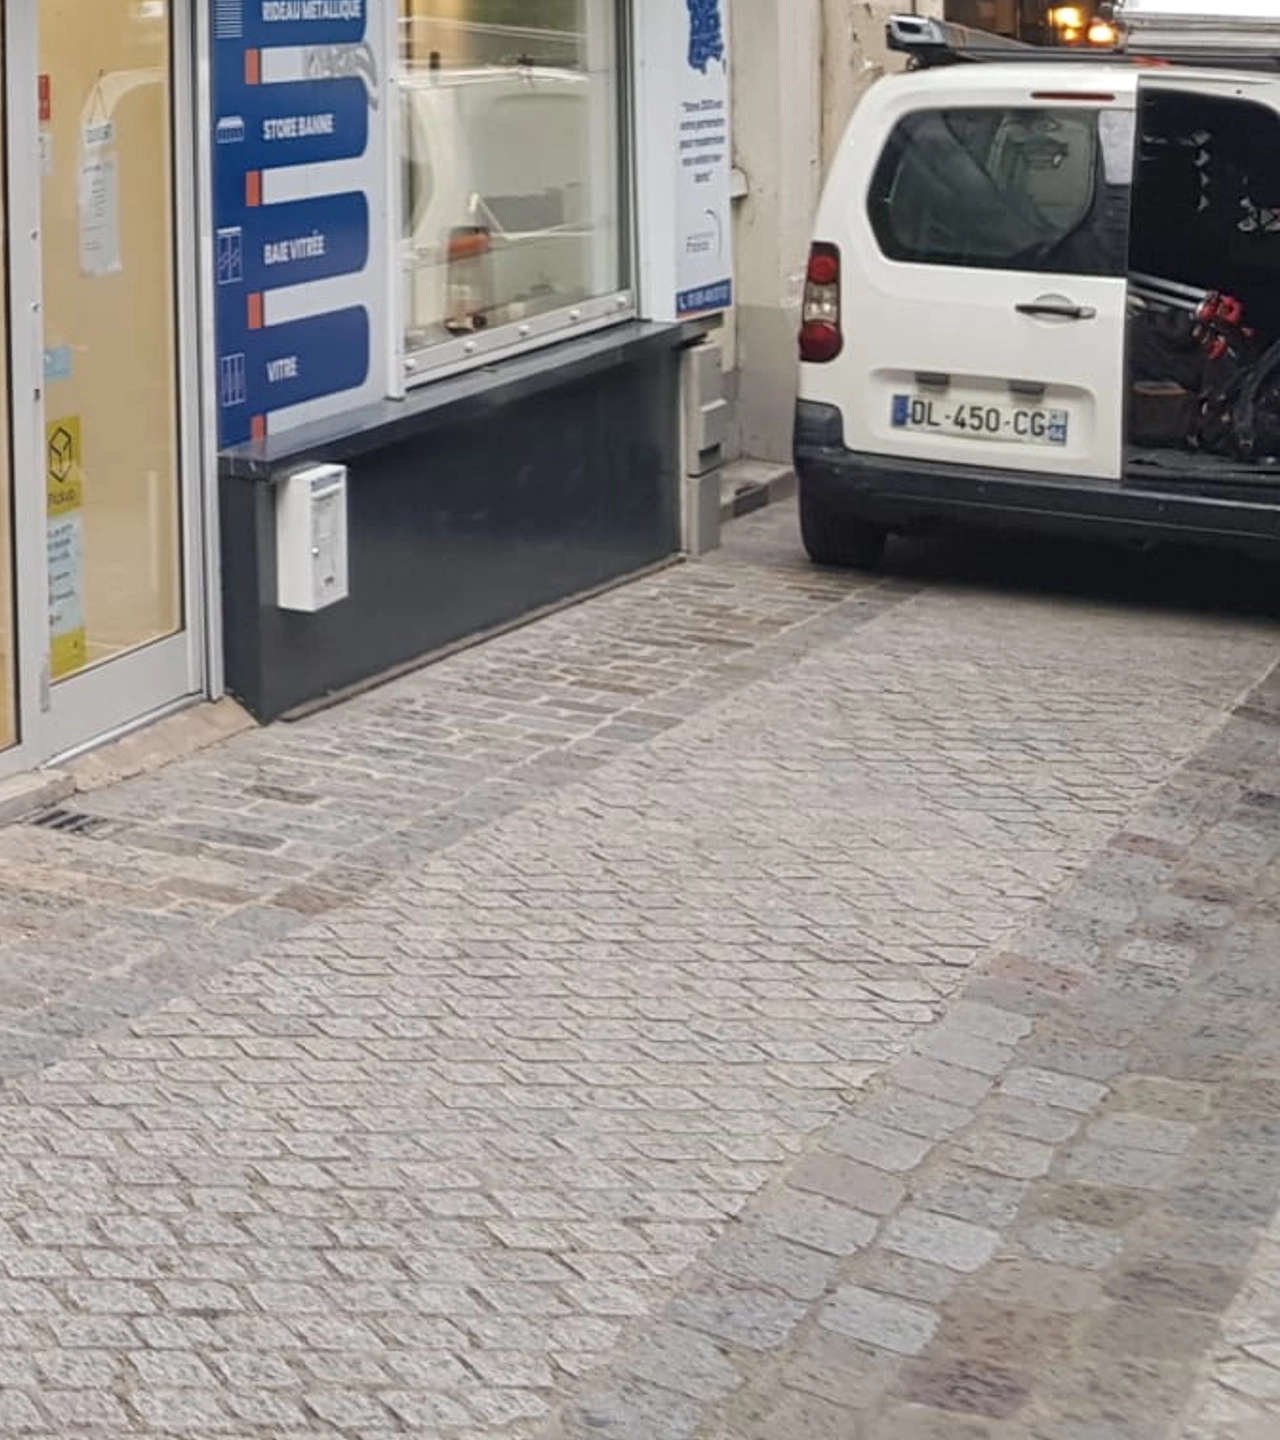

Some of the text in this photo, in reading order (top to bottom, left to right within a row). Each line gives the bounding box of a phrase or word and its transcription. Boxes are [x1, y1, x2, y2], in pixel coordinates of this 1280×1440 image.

[262, 0, 301, 22] RIDEAU
[263, 114, 335, 141] STORE BANNE
[263, 240, 291, 265] BAIE
[266, 356, 299, 382] VITRE
